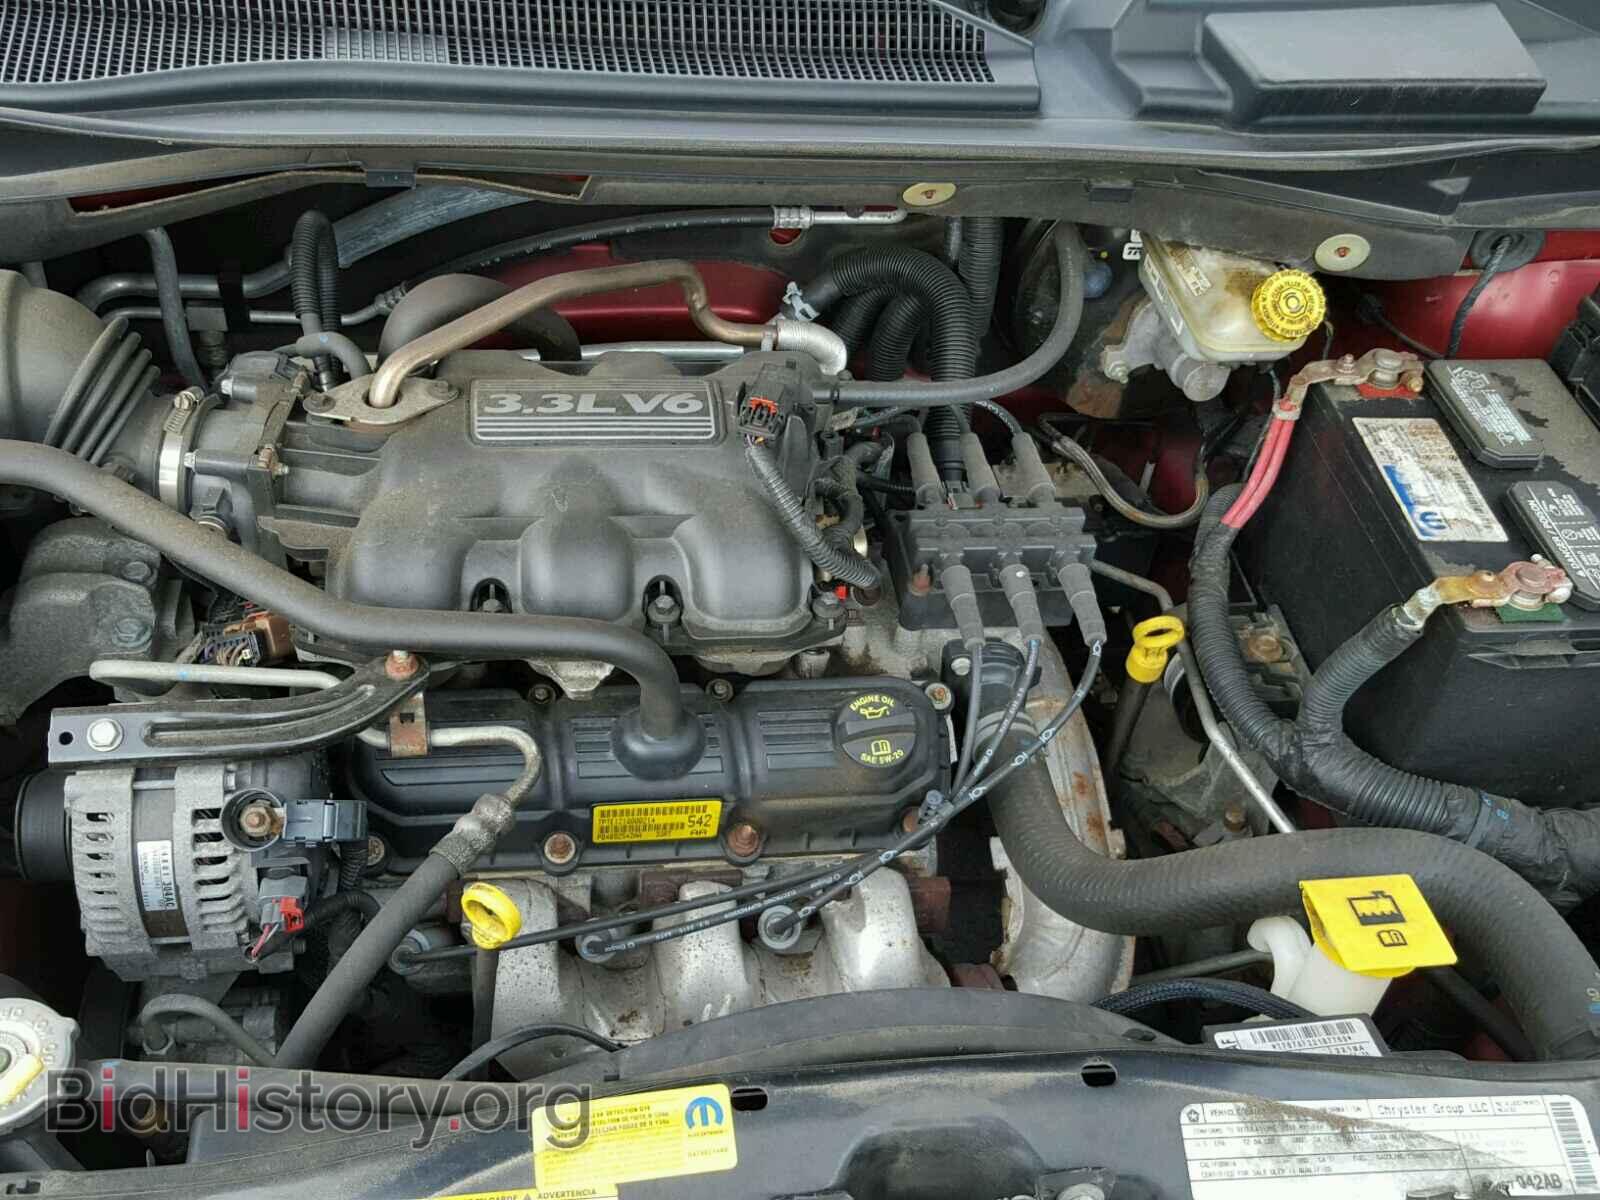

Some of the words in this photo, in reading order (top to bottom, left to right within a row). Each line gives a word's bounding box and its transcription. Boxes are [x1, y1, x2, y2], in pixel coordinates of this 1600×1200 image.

[483, 393, 616, 414] 3.3L
[621, 392, 704, 414] V6
[849, 694, 880, 711] ENGINE
[881, 695, 896, 708] OIL
[860, 752, 878, 765] SAE
[879, 749, 905, 765] 5W-20
[688, 814, 712, 828] 542
[1377, 1103, 1426, 1117] Chrysler
[1434, 1103, 1464, 1115] Group
[1468, 1102, 1488, 1113] LLC
[537, 1187, 597, 1200] ADVERTENCIA
